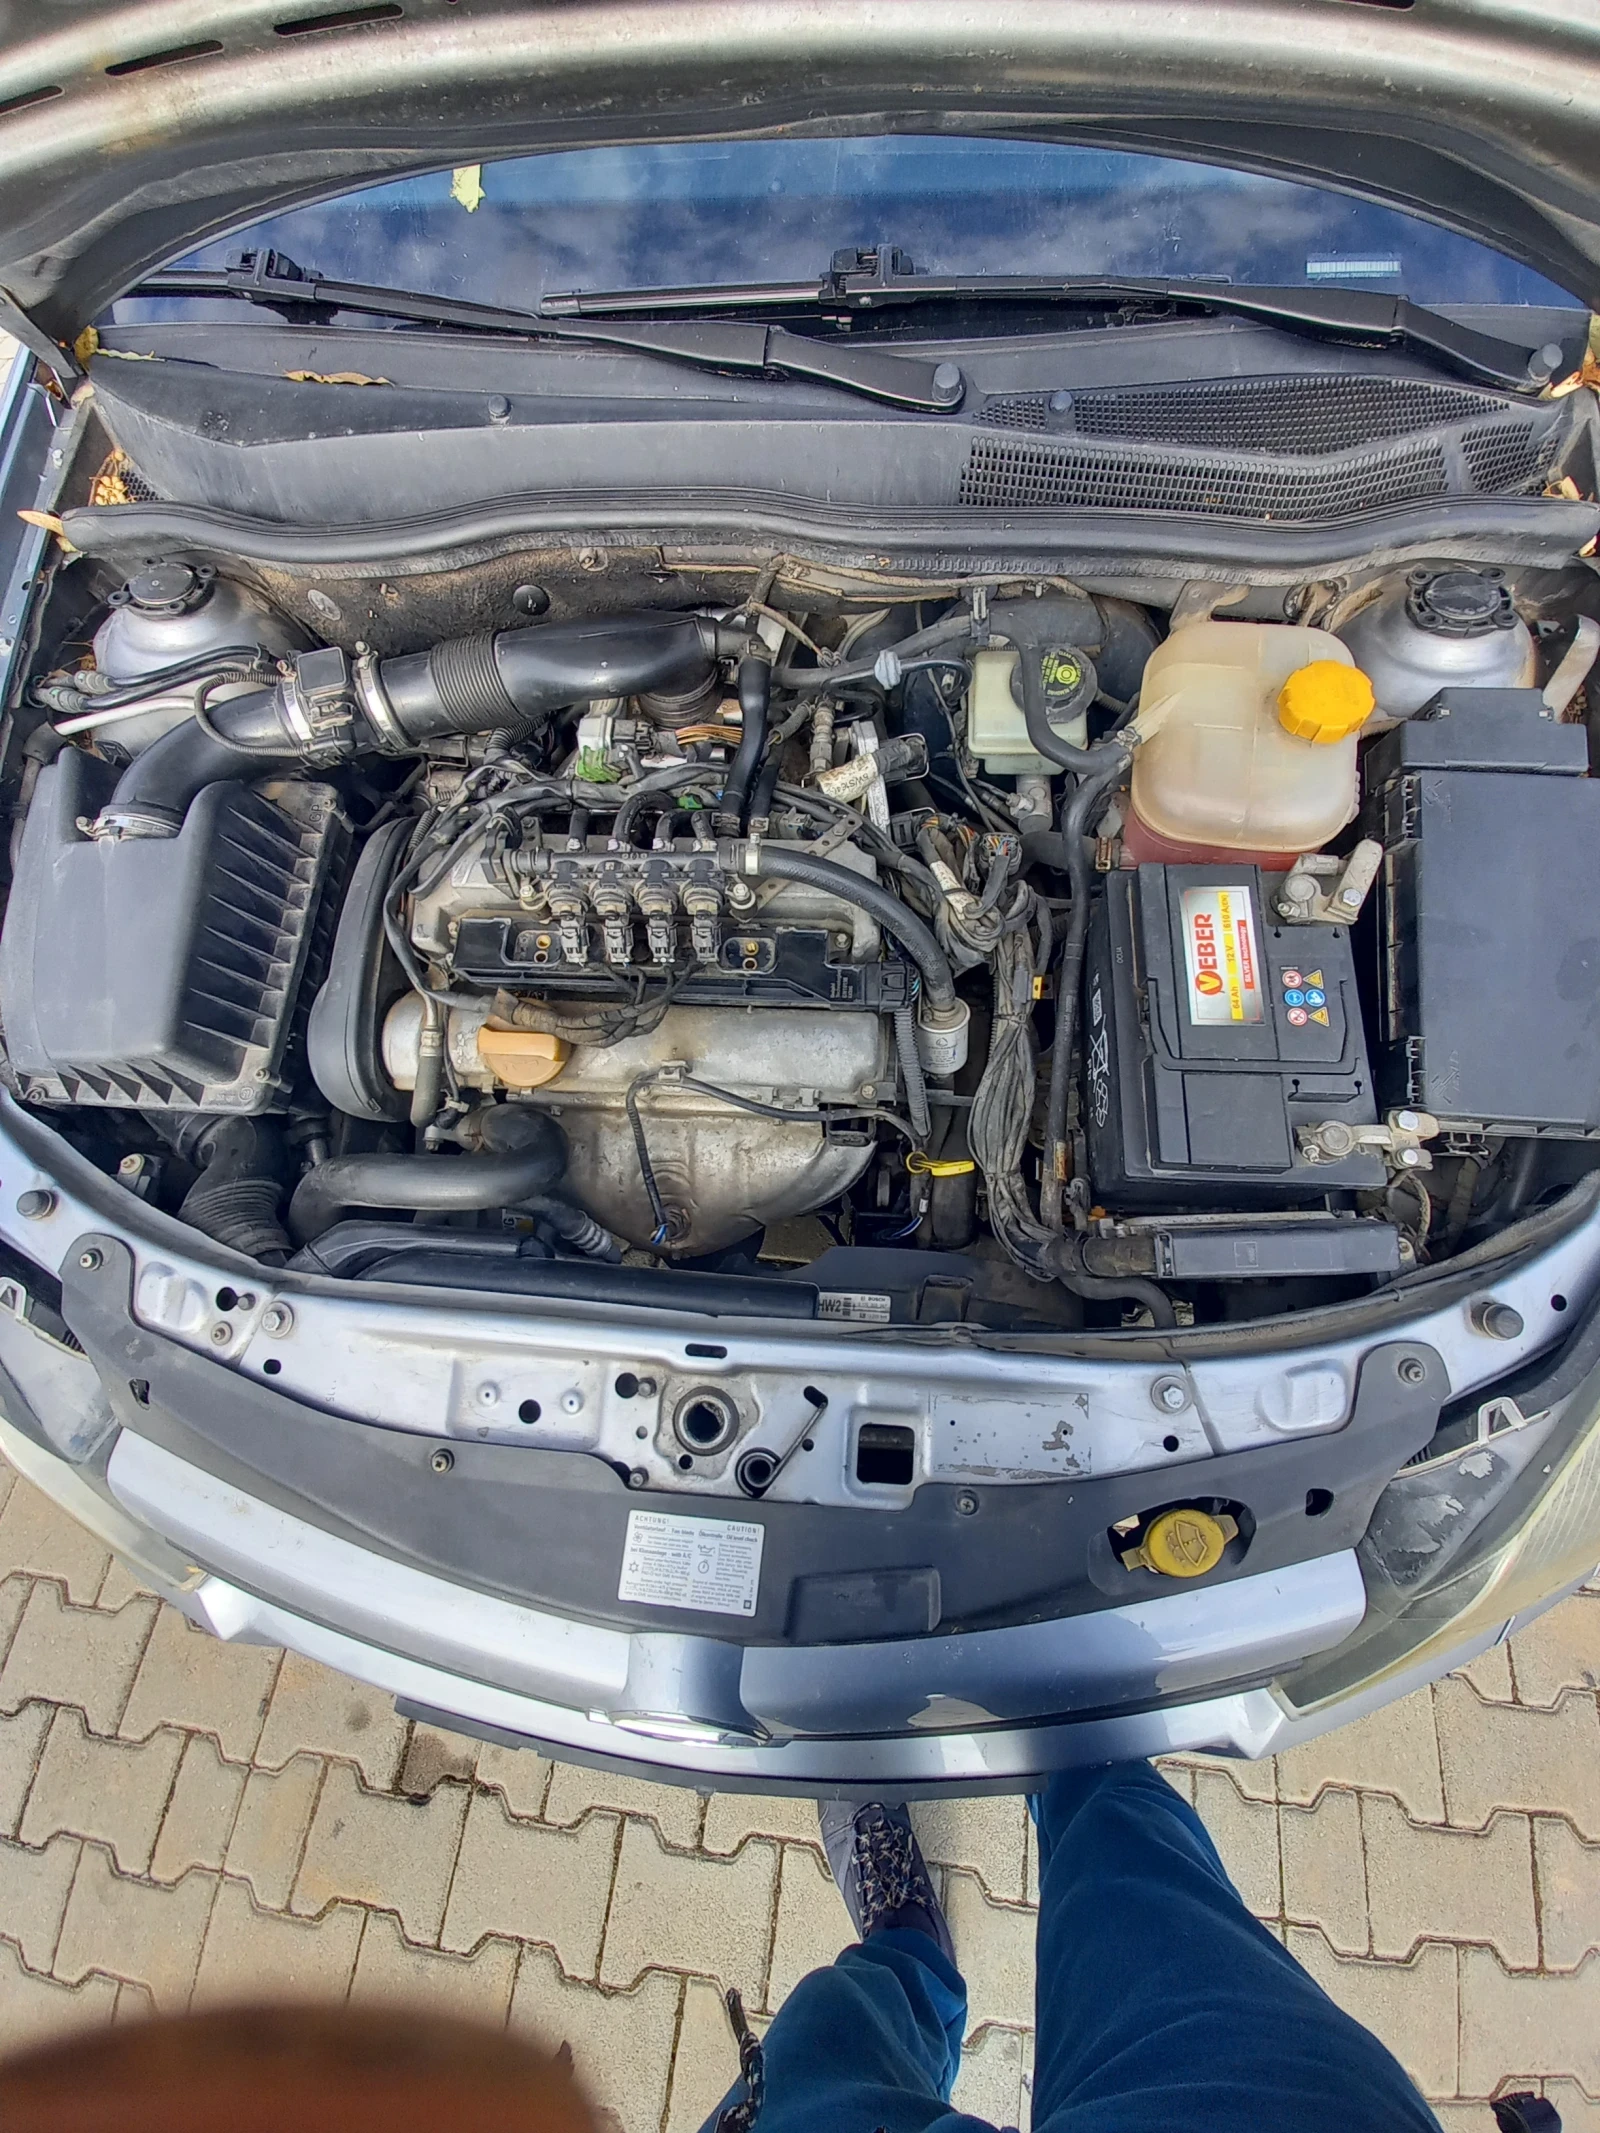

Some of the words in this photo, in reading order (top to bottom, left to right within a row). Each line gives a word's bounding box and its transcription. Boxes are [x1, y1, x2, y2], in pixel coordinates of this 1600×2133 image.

[1223, 914, 1231, 928] 610
[1224, 944, 1233, 952] V
[1240, 926, 1249, 959] technology
[1194, 913, 1223, 995] VEBER
[1227, 952, 1235, 963] 12
[1243, 959, 1251, 983] SILVER
[1230, 986, 1239, 998] Ah
[1232, 999, 1240, 1009] 64
[634, 1515, 670, 1525] ACHTUNG!
[726, 1524, 761, 1534] CAUTION!
